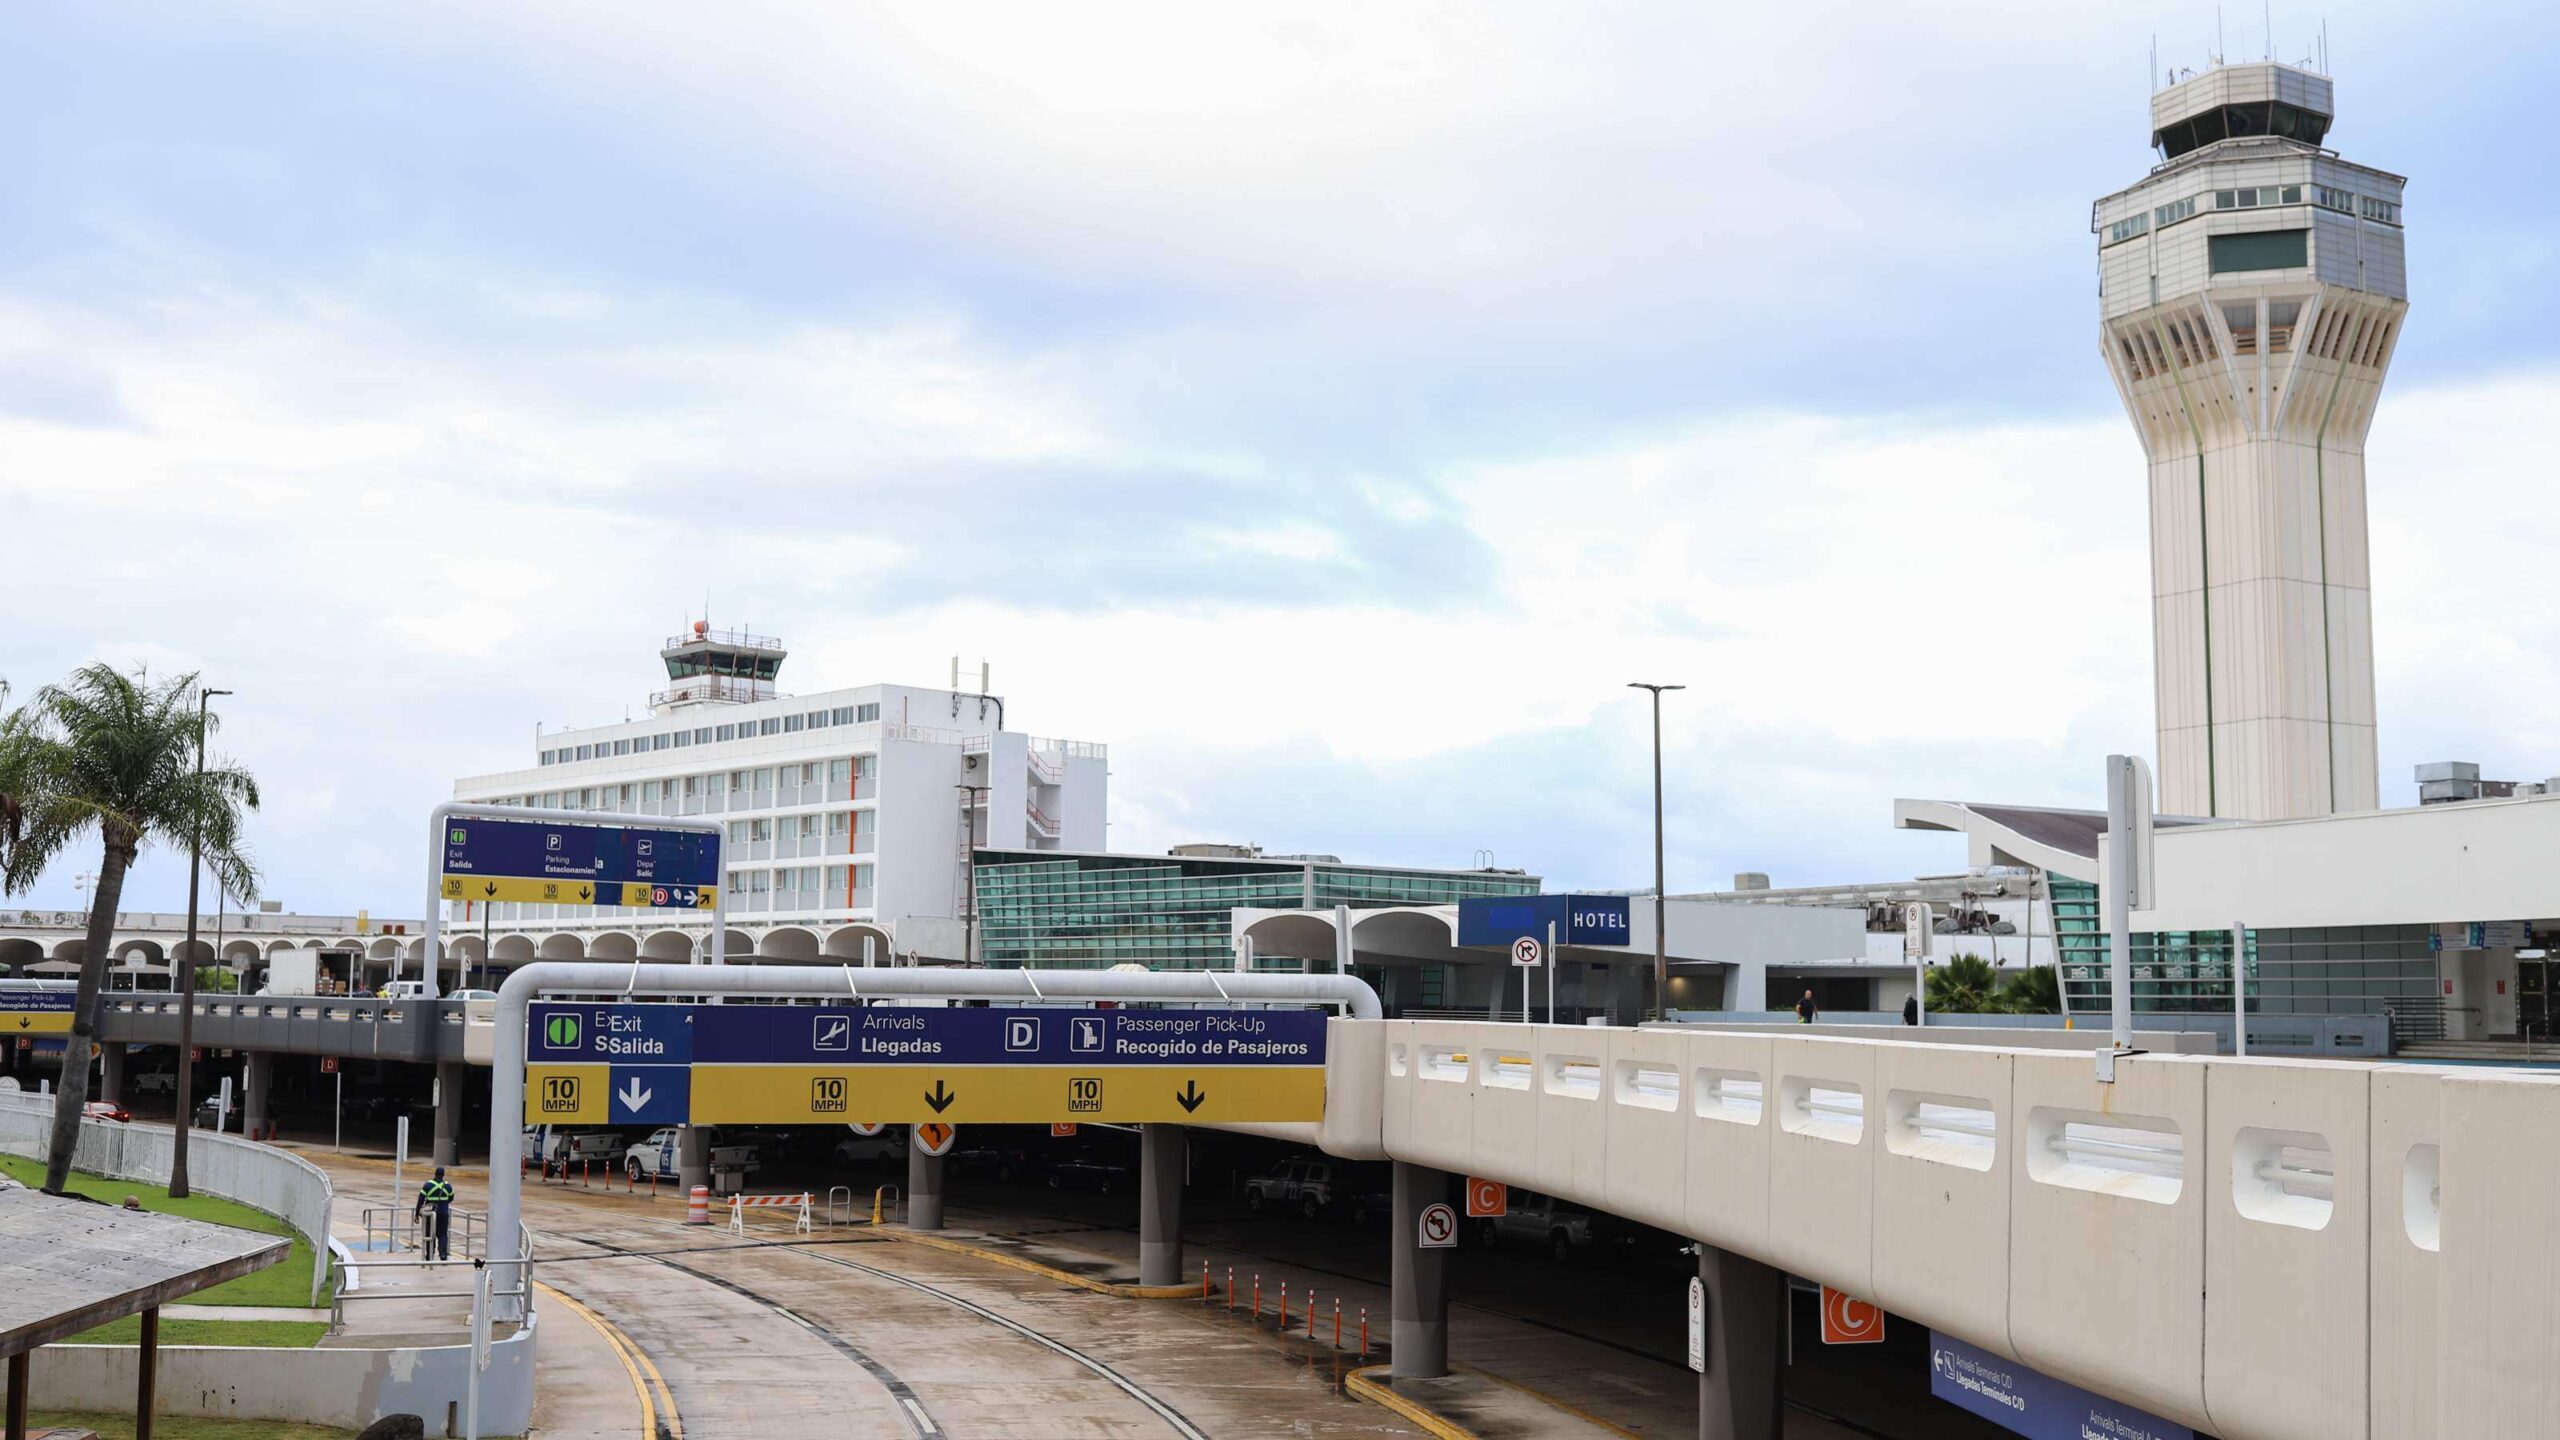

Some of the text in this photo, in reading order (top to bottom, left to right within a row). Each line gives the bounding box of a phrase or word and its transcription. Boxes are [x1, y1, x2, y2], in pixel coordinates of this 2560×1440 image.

[550, 837, 559, 848] P
[449, 850, 463, 858] Exit
[545, 855, 570, 865] Parking
[449, 860, 473, 869] Salida
[545, 864, 597, 876] Estacionamien
[636, 859, 656, 868] Depa
[450, 881, 460, 890] 10
[547, 884, 556, 893] 10
[656, 891, 665, 902] D
[1574, 912, 1626, 928] HOTEL
[611, 1015, 642, 1032] Exit
[862, 1013, 925, 1030] Arrivals
[1116, 1015, 1266, 1035] Passenger Pick-Up
[1012, 1022, 1033, 1047] D
[608, 1037, 664, 1054] Salida
[861, 1037, 942, 1057] Llegadas
[1116, 1039, 1308, 1058] Recogido de Pasajeros
[327, 1060, 334, 1069] D
[548, 1079, 575, 1099] 10
[817, 1080, 842, 1099] 10
[1074, 1080, 1098, 1099] 10
[545, 1099, 576, 1110] MPH
[815, 1099, 843, 1110] MPH
[1071, 1099, 1099, 1110] MPH
[1479, 1185, 1495, 1208] C
[1842, 1296, 1865, 1329] C
[1956, 1371, 2025, 1411] Llegadas Terminales C/D
[2089, 1409, 2115, 1433] Arrivals
[2114, 1418, 2145, 1440] Terminal
